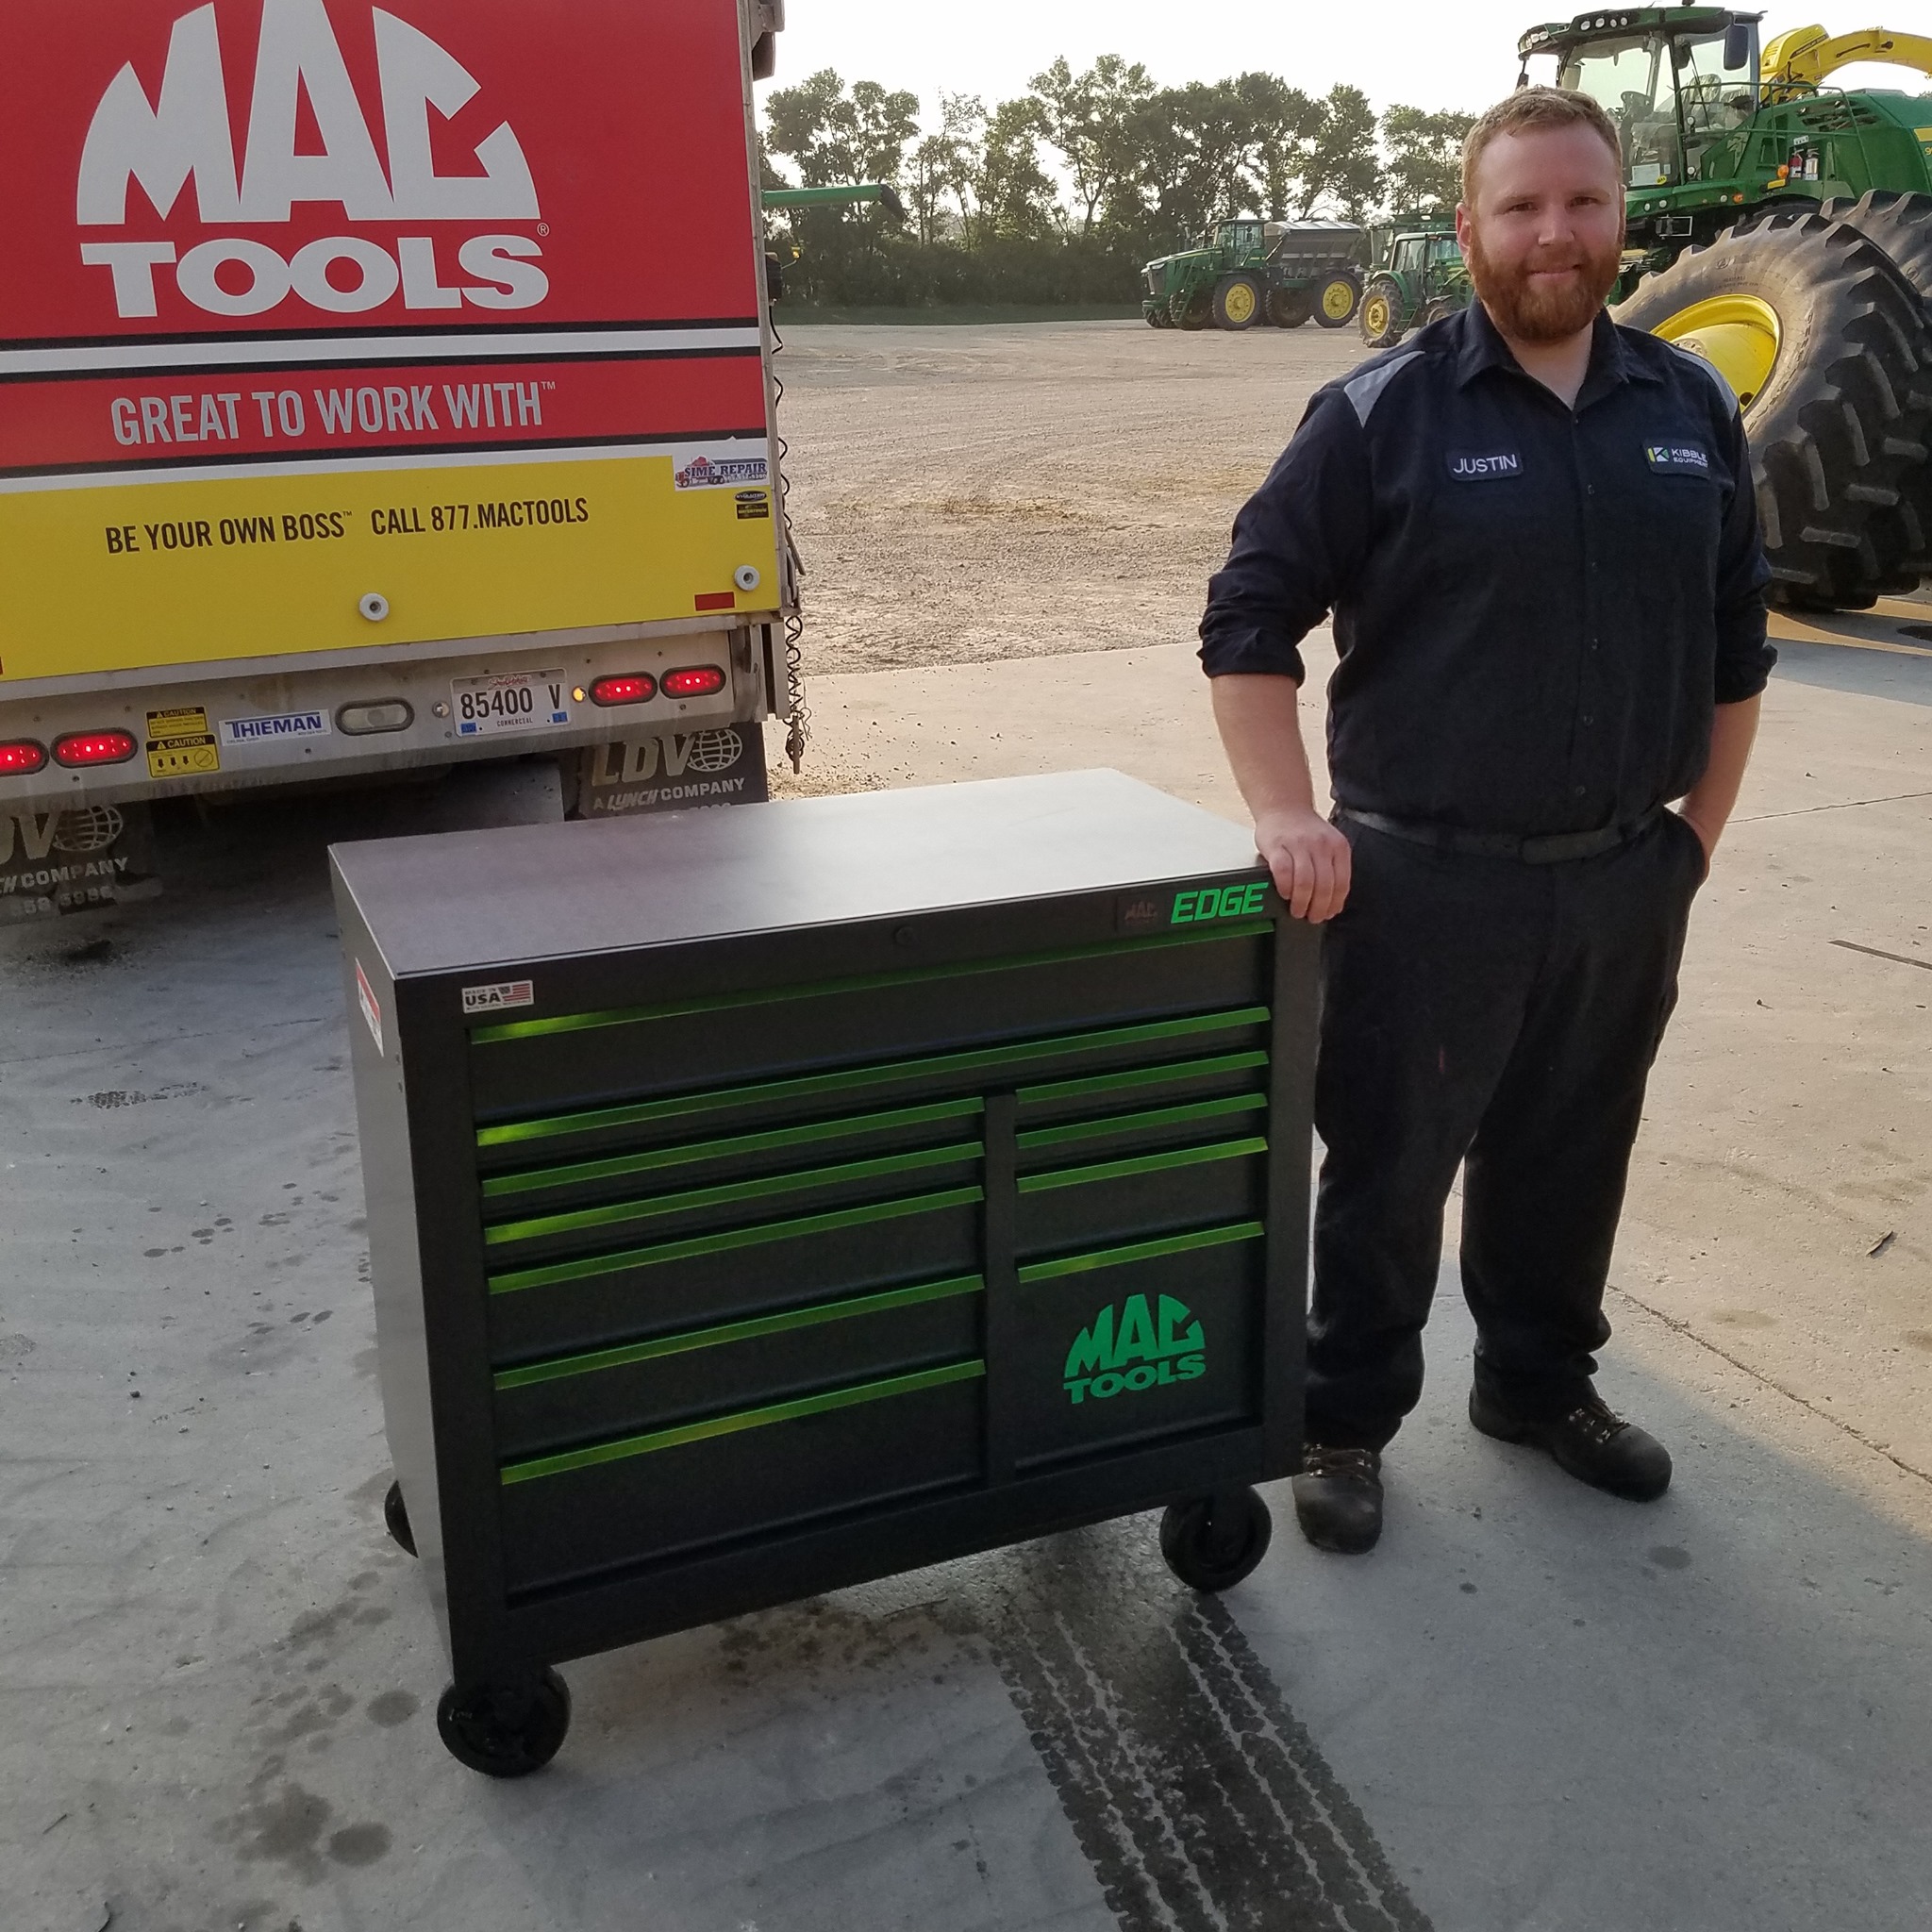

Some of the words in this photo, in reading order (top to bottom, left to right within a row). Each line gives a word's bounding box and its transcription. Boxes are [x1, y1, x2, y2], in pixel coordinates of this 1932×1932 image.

[76, 0, 541, 225] MAC
[110, 392, 241, 446] GREAT
[252, 390, 306, 438] TO
[314, 385, 440, 435] WORK
[684, 466, 716, 477] SIME
[720, 462, 768, 475] REPAIR
[1453, 454, 1518, 474] JUSTIN
[1671, 448, 1708, 462] KIBBLE
[106, 525, 141, 555] BE
[144, 520, 214, 551] YOUR
[220, 516, 276, 546] OWN
[371, 508, 426, 536] CALL
[431, 497, 589, 532] 877.MACTOOLS
[163, 708, 197, 717] CAUTION
[460, 687, 533, 720] 85400
[548, 684, 560, 709] V
[225, 712, 322, 739] THIEMAN
[496, 717, 534, 727] COMMERCIAL
[167, 737, 207, 748] CAUTION
[591, 732, 698, 787] LDV
[593, 797, 604, 810] A
[608, 789, 660, 811] LYNCH
[660, 777, 746, 801] COMPANY
[21, 857, 128, 889] COMPANY
[1171, 882, 1269, 924] EDGE
[465, 992, 501, 1007] USA
[1064, 1293, 1206, 1378] MAC
[1063, 1354, 1207, 1405] TOOLS
